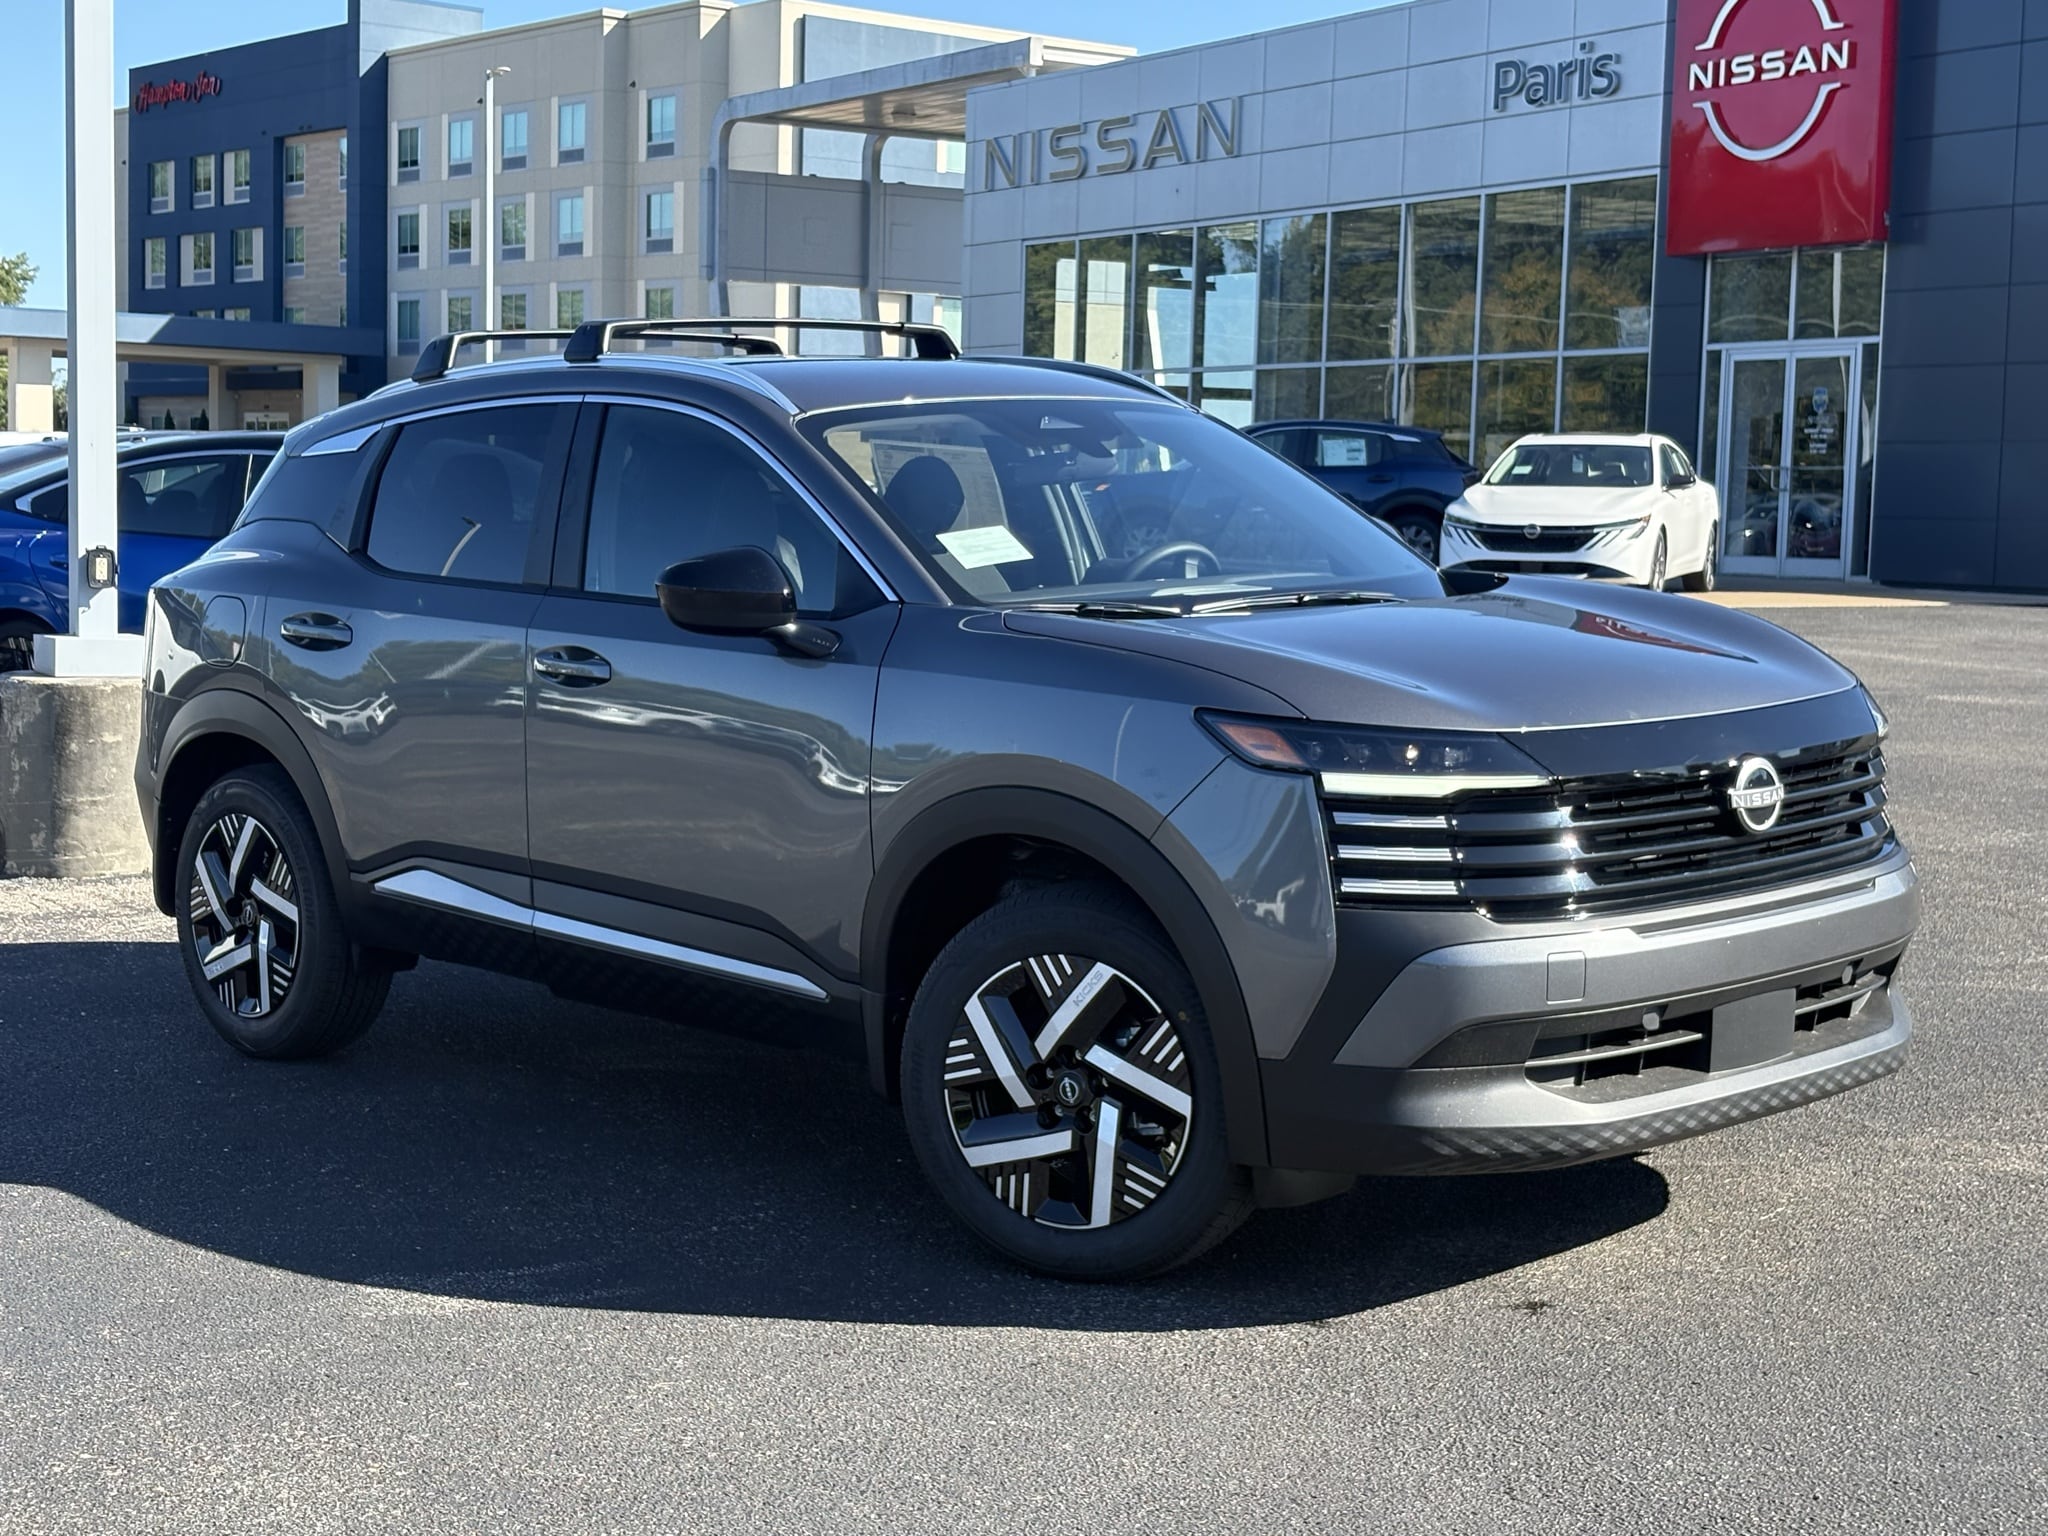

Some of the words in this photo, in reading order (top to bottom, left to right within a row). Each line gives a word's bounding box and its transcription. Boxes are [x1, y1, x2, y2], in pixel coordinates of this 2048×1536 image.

[134, 79, 191, 113] Hampton
[192, 70, 221, 103] Inn
[1493, 41, 1620, 111] Paris
[1688, 39, 1850, 92] NISSAN
[984, 96, 1240, 191] NISSAN
[1732, 785, 1784, 808] NISSAN
